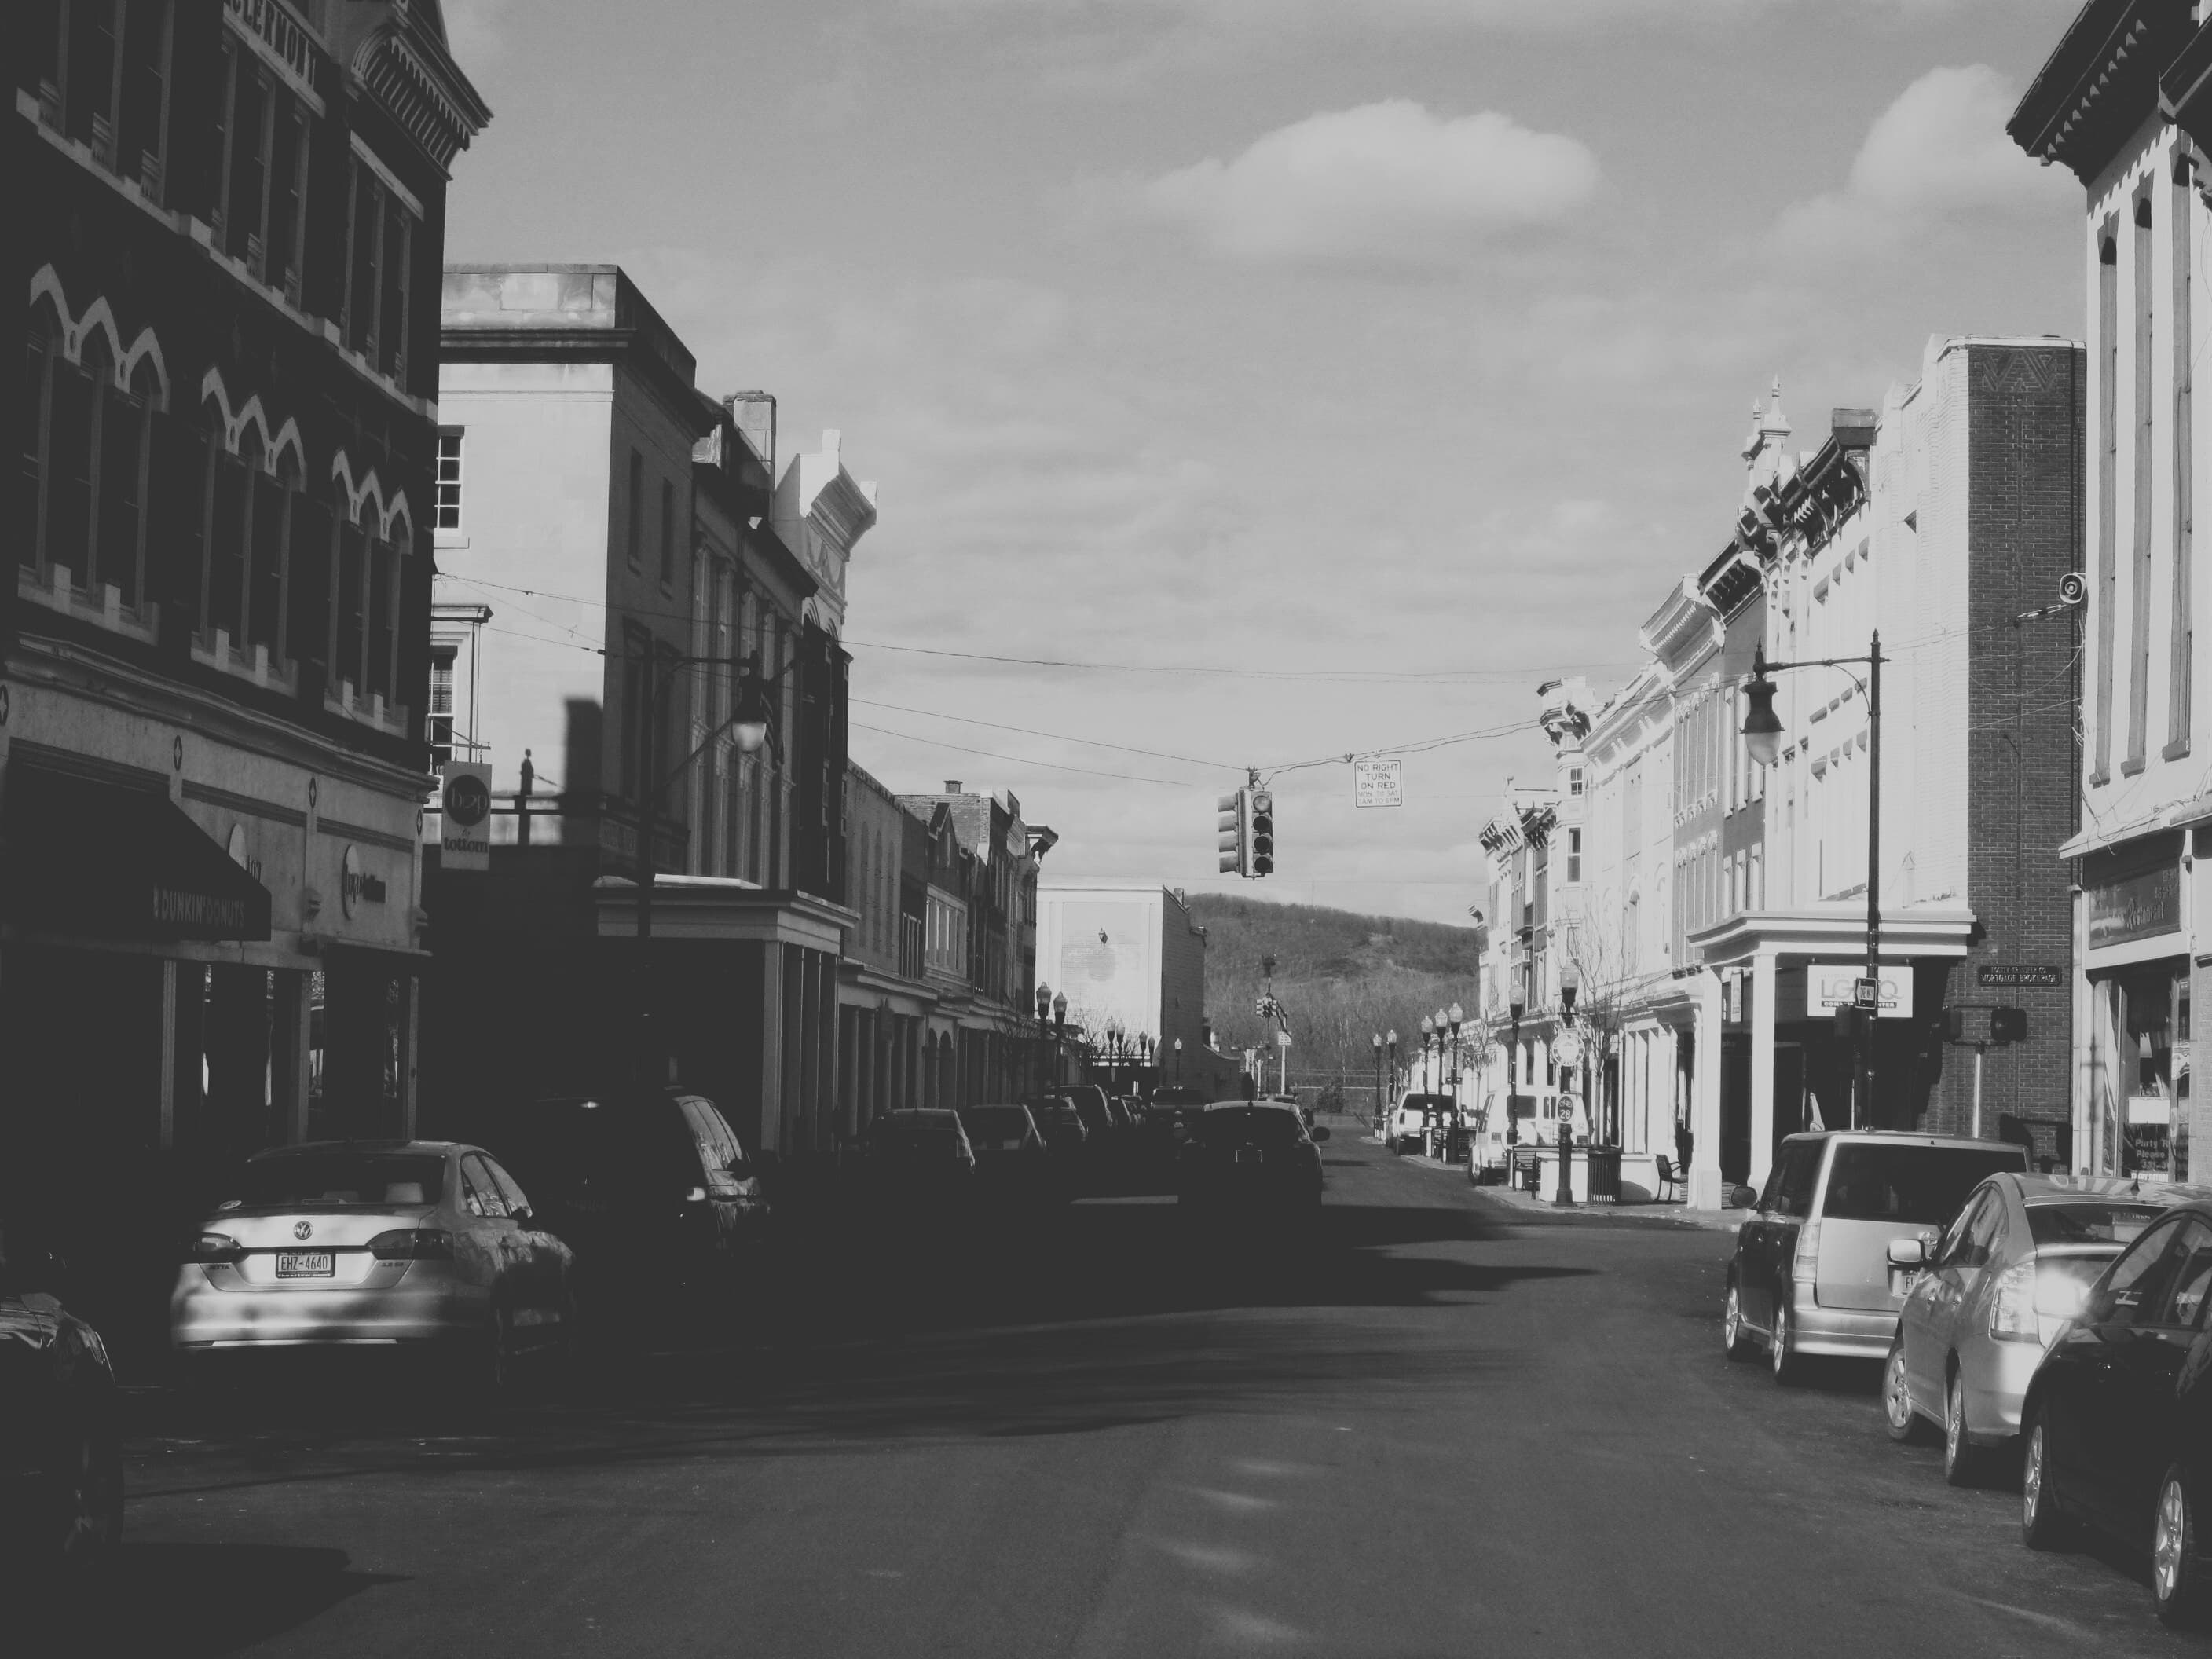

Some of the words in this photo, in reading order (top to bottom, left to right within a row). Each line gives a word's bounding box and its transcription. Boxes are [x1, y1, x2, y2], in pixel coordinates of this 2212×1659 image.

[1372, 763, 1398, 771] RIGHT
[206, 895, 245, 929] DONUTS
[1560, 1109, 1571, 1119] 28
